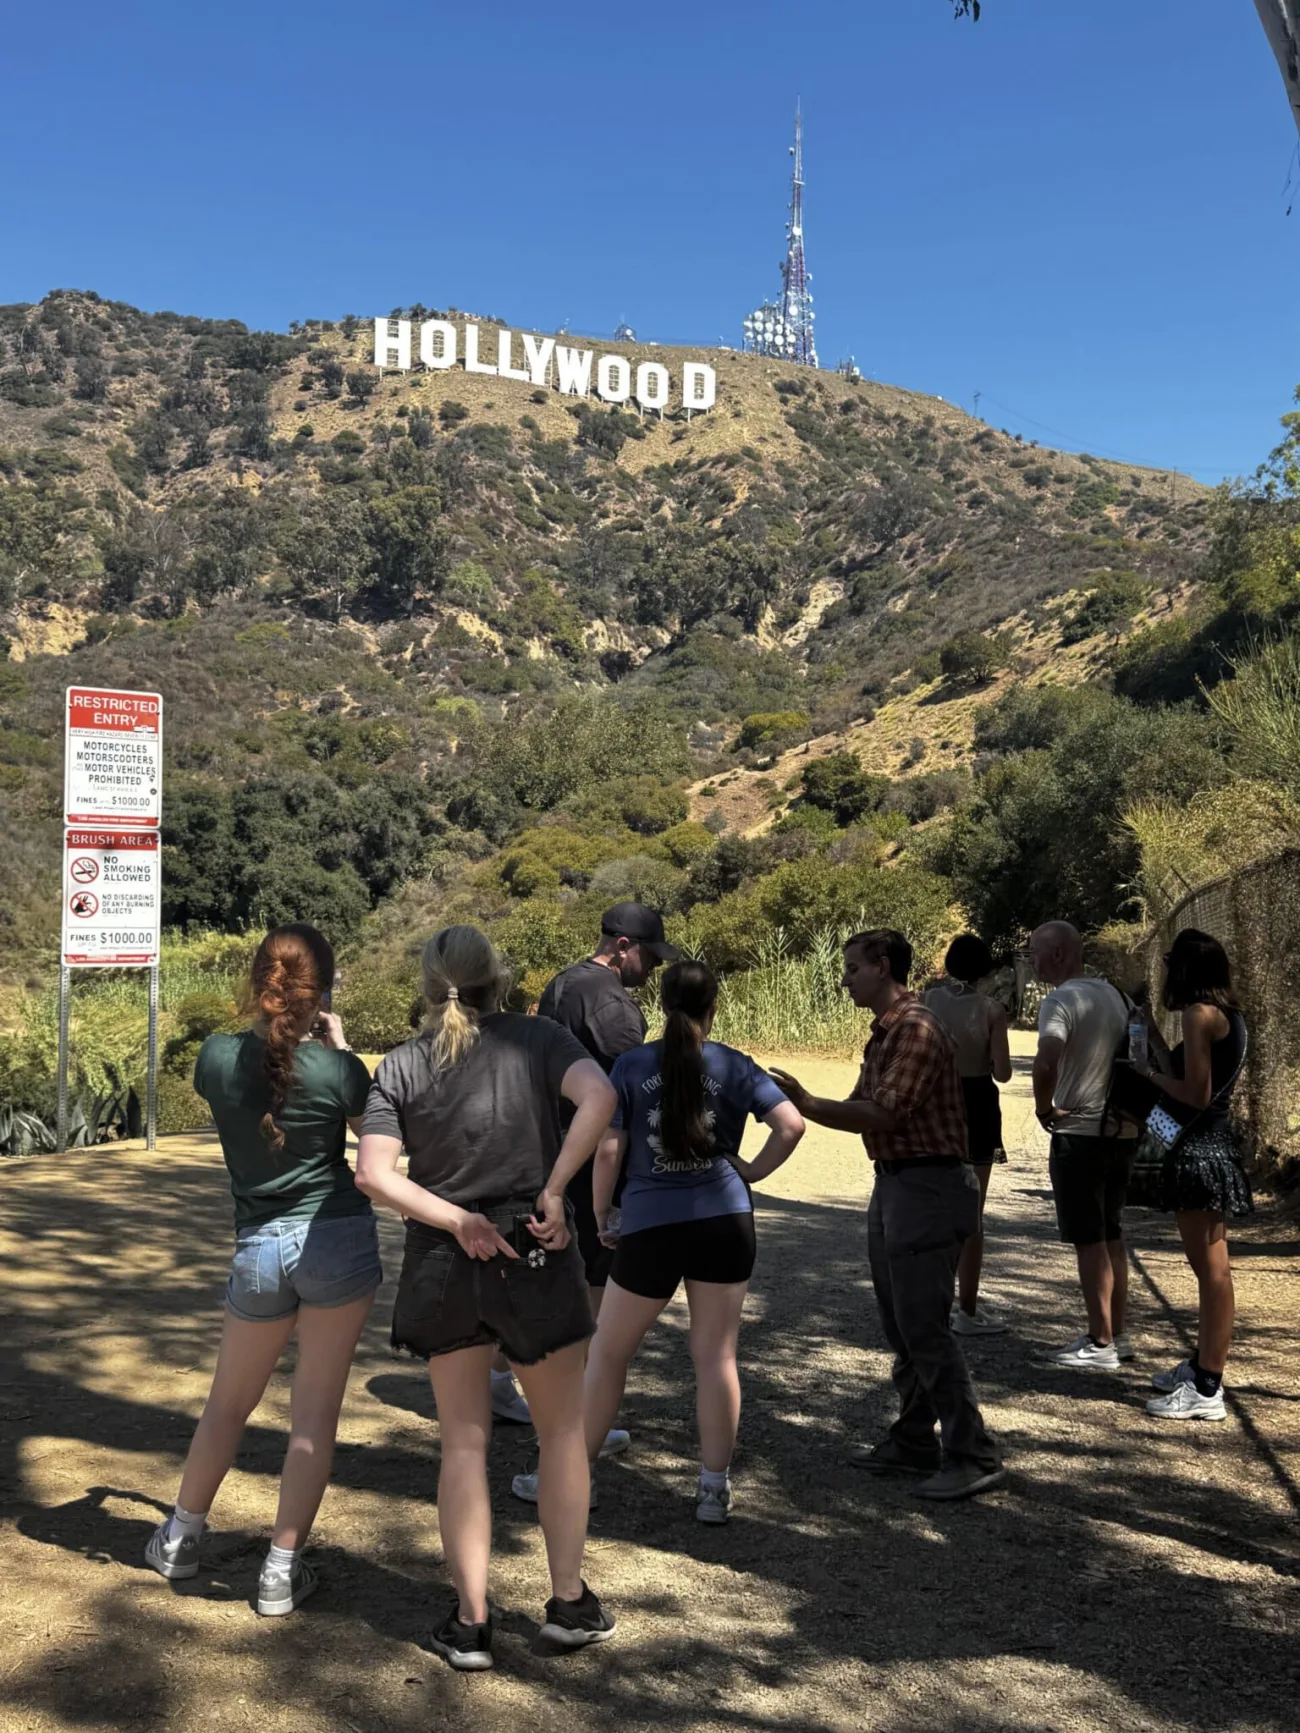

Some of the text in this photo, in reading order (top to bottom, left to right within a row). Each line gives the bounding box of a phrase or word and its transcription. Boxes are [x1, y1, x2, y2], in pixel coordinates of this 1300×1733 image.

[374, 317, 716, 410] HOLLYWOOD
[74, 696, 157, 713] RESTRICTED
[94, 712, 138, 726] ENTRY
[84, 741, 147, 753] MOTORCYCLES
[76, 752, 153, 764] MOTORSCOOTERS
[85, 764, 114, 772] MOTOR
[116, 765, 156, 775] VEHICLES
[89, 774, 142, 785] PROHIBITED
[112, 796, 150, 806] $1000.00
[71, 834, 152, 846] BRUSH AREA
[104, 856, 118, 864] NO
[104, 865, 151, 873] SMOKING
[100, 932, 152, 944] $1000.00
